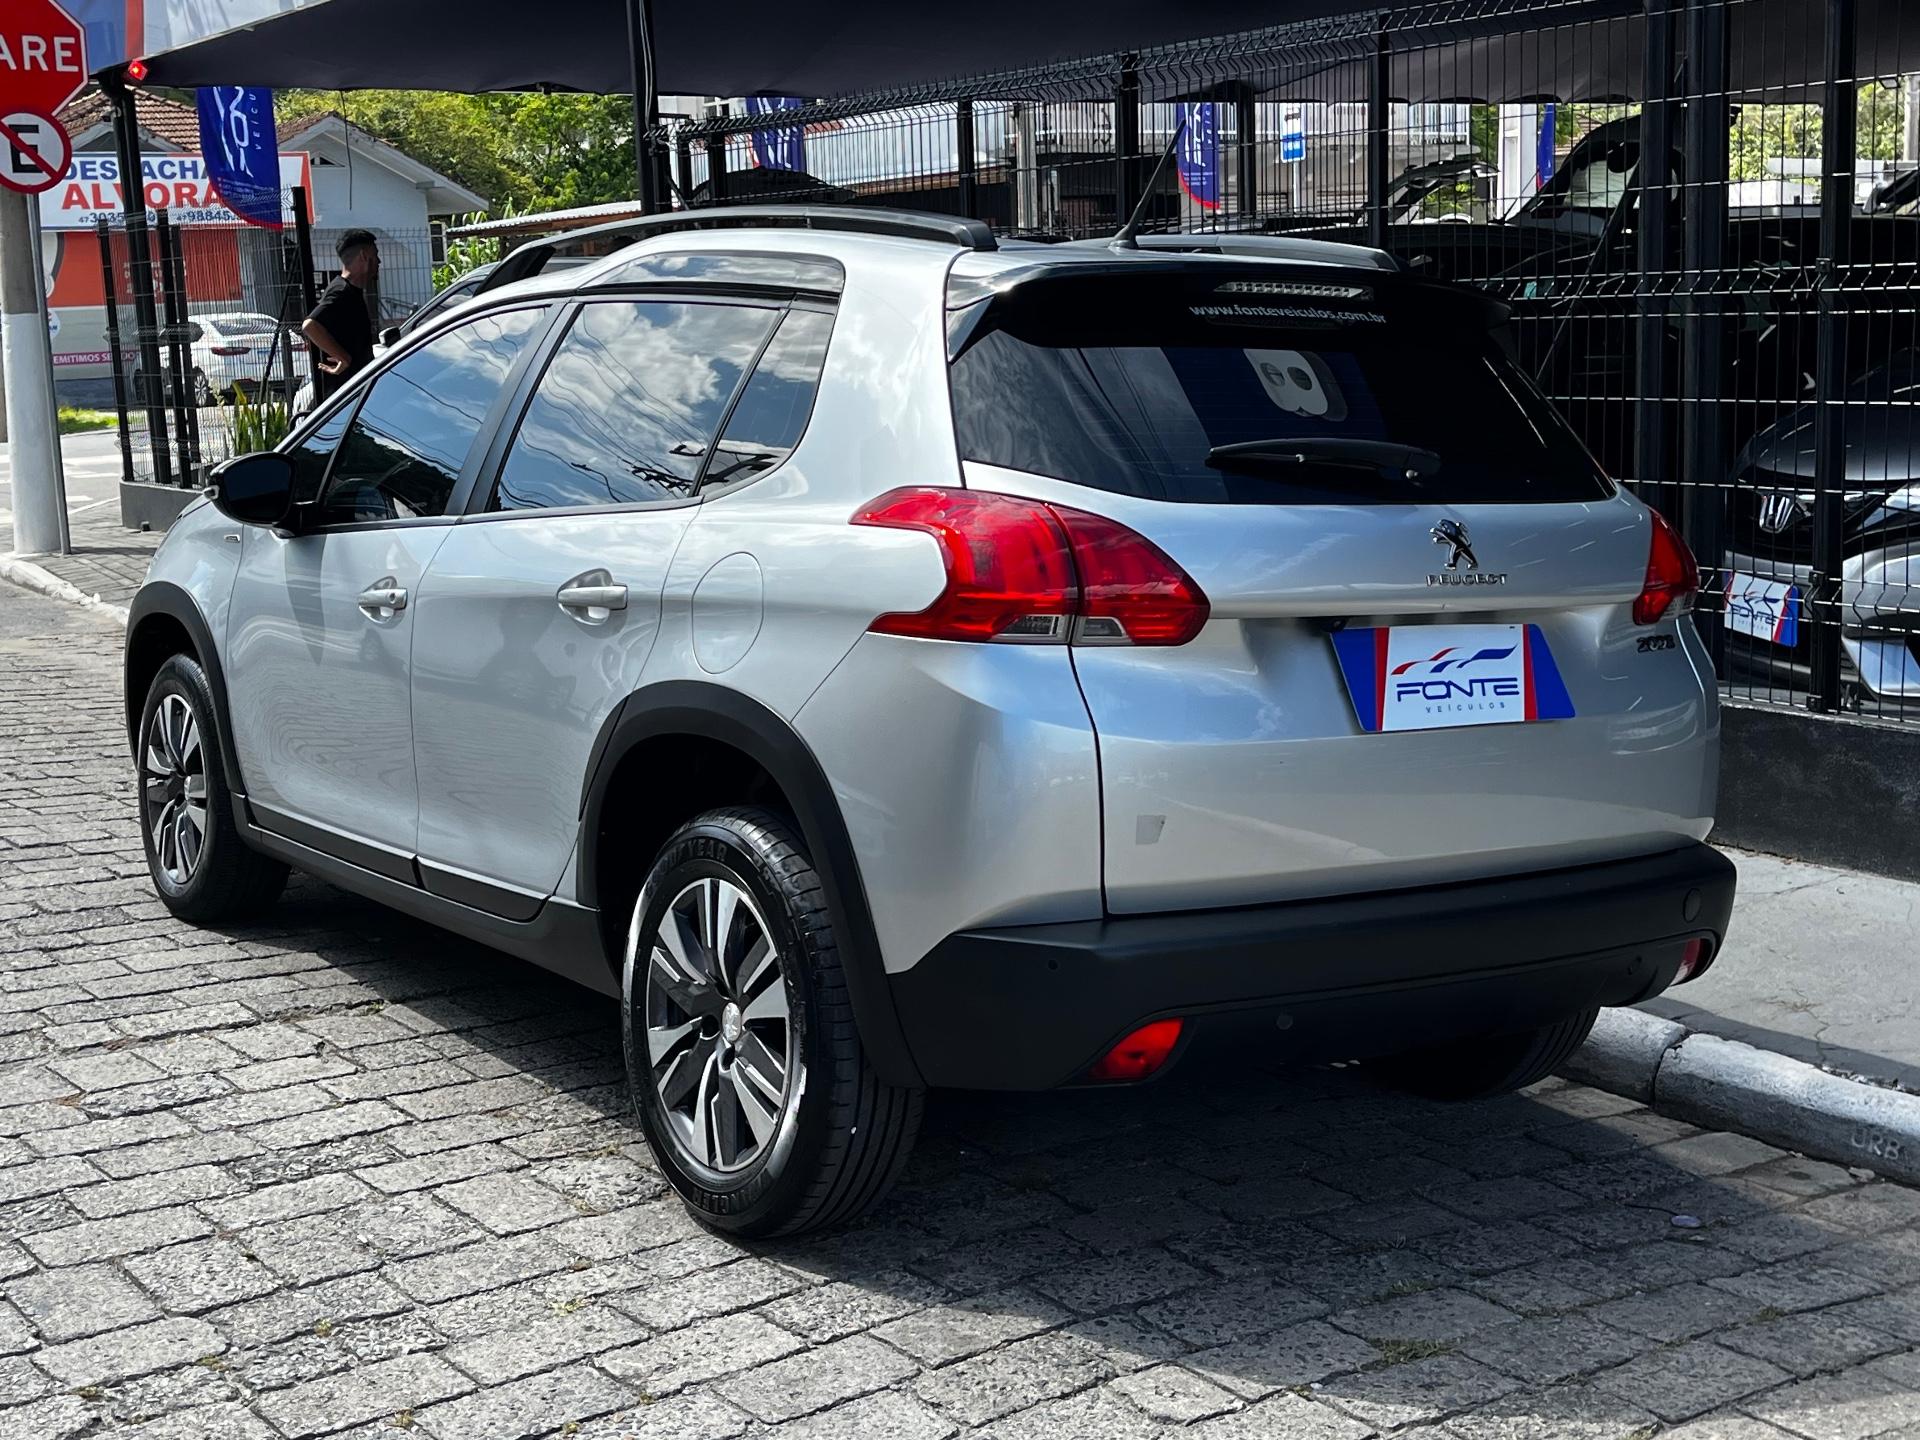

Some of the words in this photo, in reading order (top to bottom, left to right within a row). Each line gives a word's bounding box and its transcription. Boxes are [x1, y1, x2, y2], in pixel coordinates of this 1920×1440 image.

[64, 160, 209, 180] DESACH
[53, 354, 100, 364] EMITIMOS
[1425, 573, 1508, 588] PEUGEOT
[1396, 677, 1520, 702] FONTE
